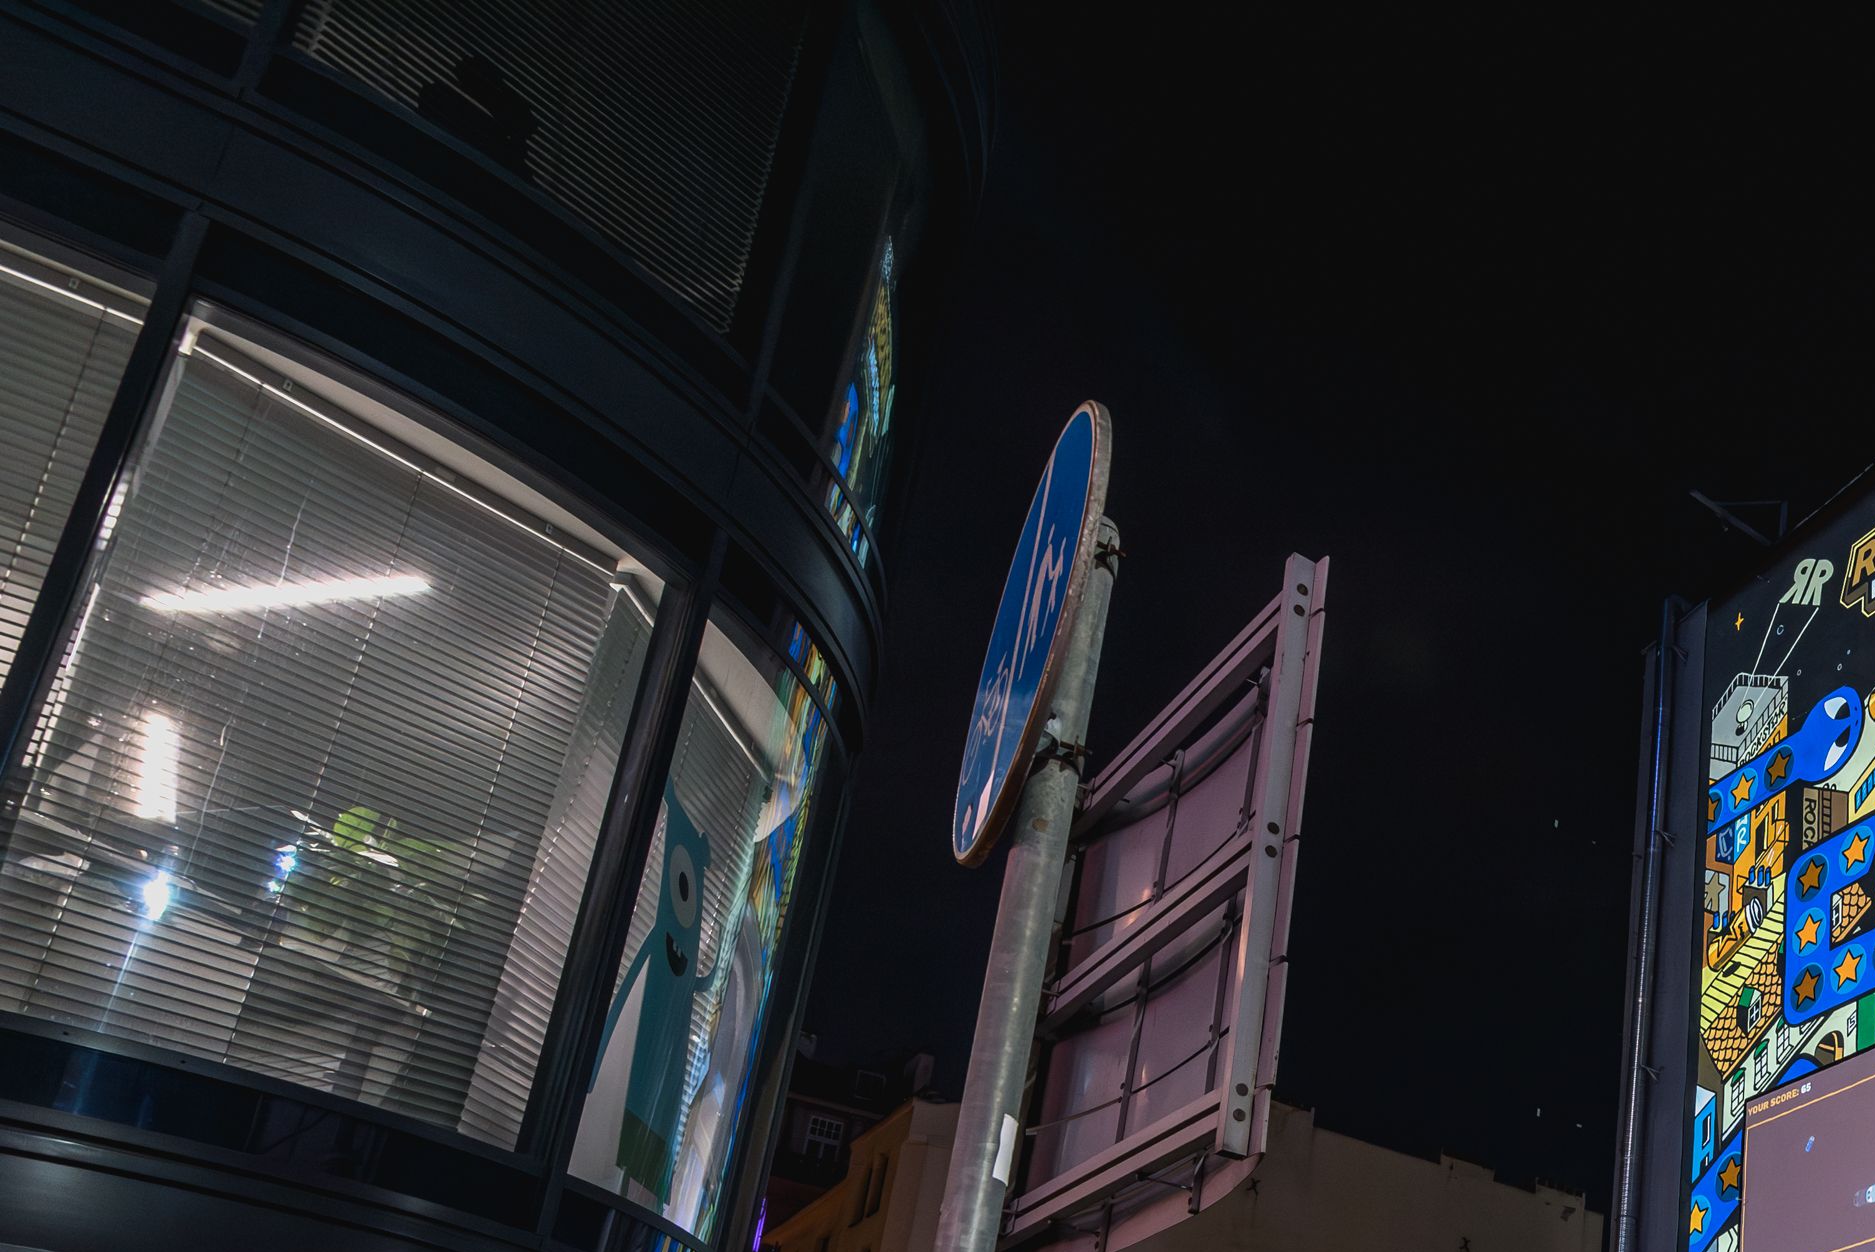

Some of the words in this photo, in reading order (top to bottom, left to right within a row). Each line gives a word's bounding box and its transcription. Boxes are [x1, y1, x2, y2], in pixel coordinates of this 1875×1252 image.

[1748, 1101, 1769, 1116] YOUR
[1770, 1088, 1800, 1107] SCORE:
[1801, 1082, 1812, 1094] 65
